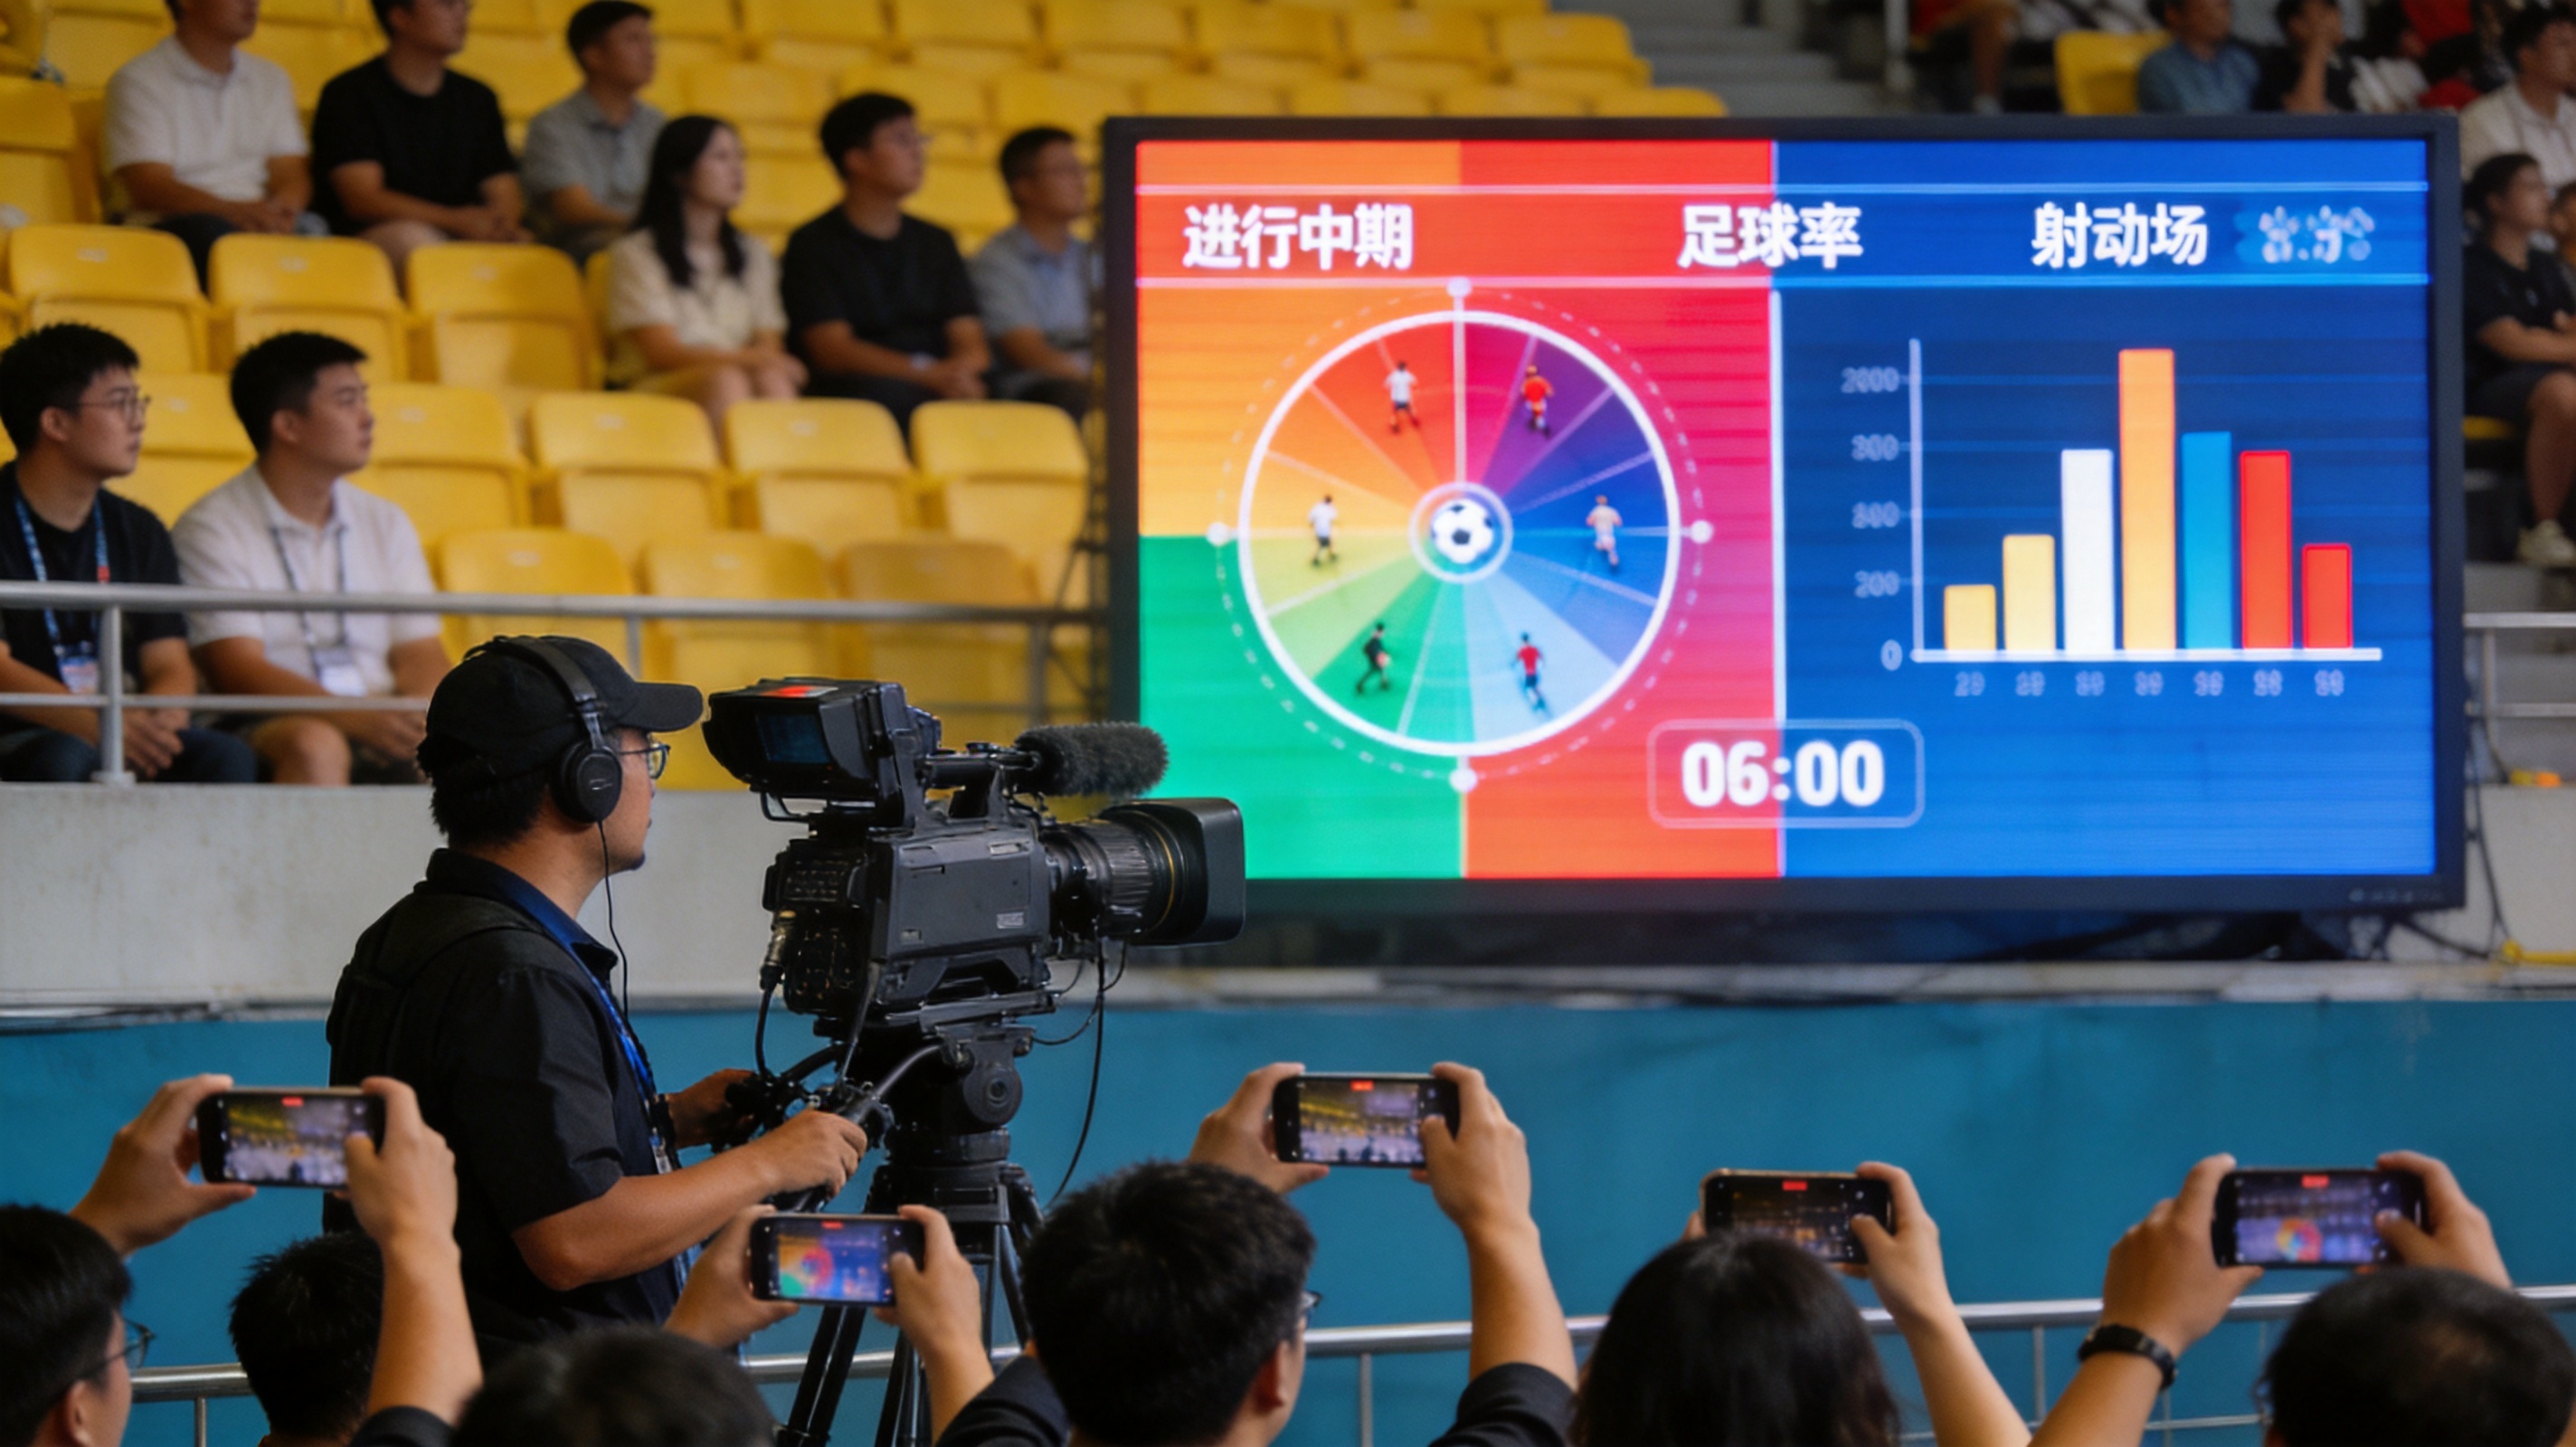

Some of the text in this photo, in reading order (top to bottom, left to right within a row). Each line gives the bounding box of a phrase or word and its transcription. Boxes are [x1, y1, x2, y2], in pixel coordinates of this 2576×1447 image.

[1182, 203, 1413, 270] 进行中期
[1677, 201, 1863, 269] 足球率
[2031, 201, 2208, 269] 射动场
[1880, 639, 1903, 671] 0
[1681, 739, 1885, 808] 06:00
